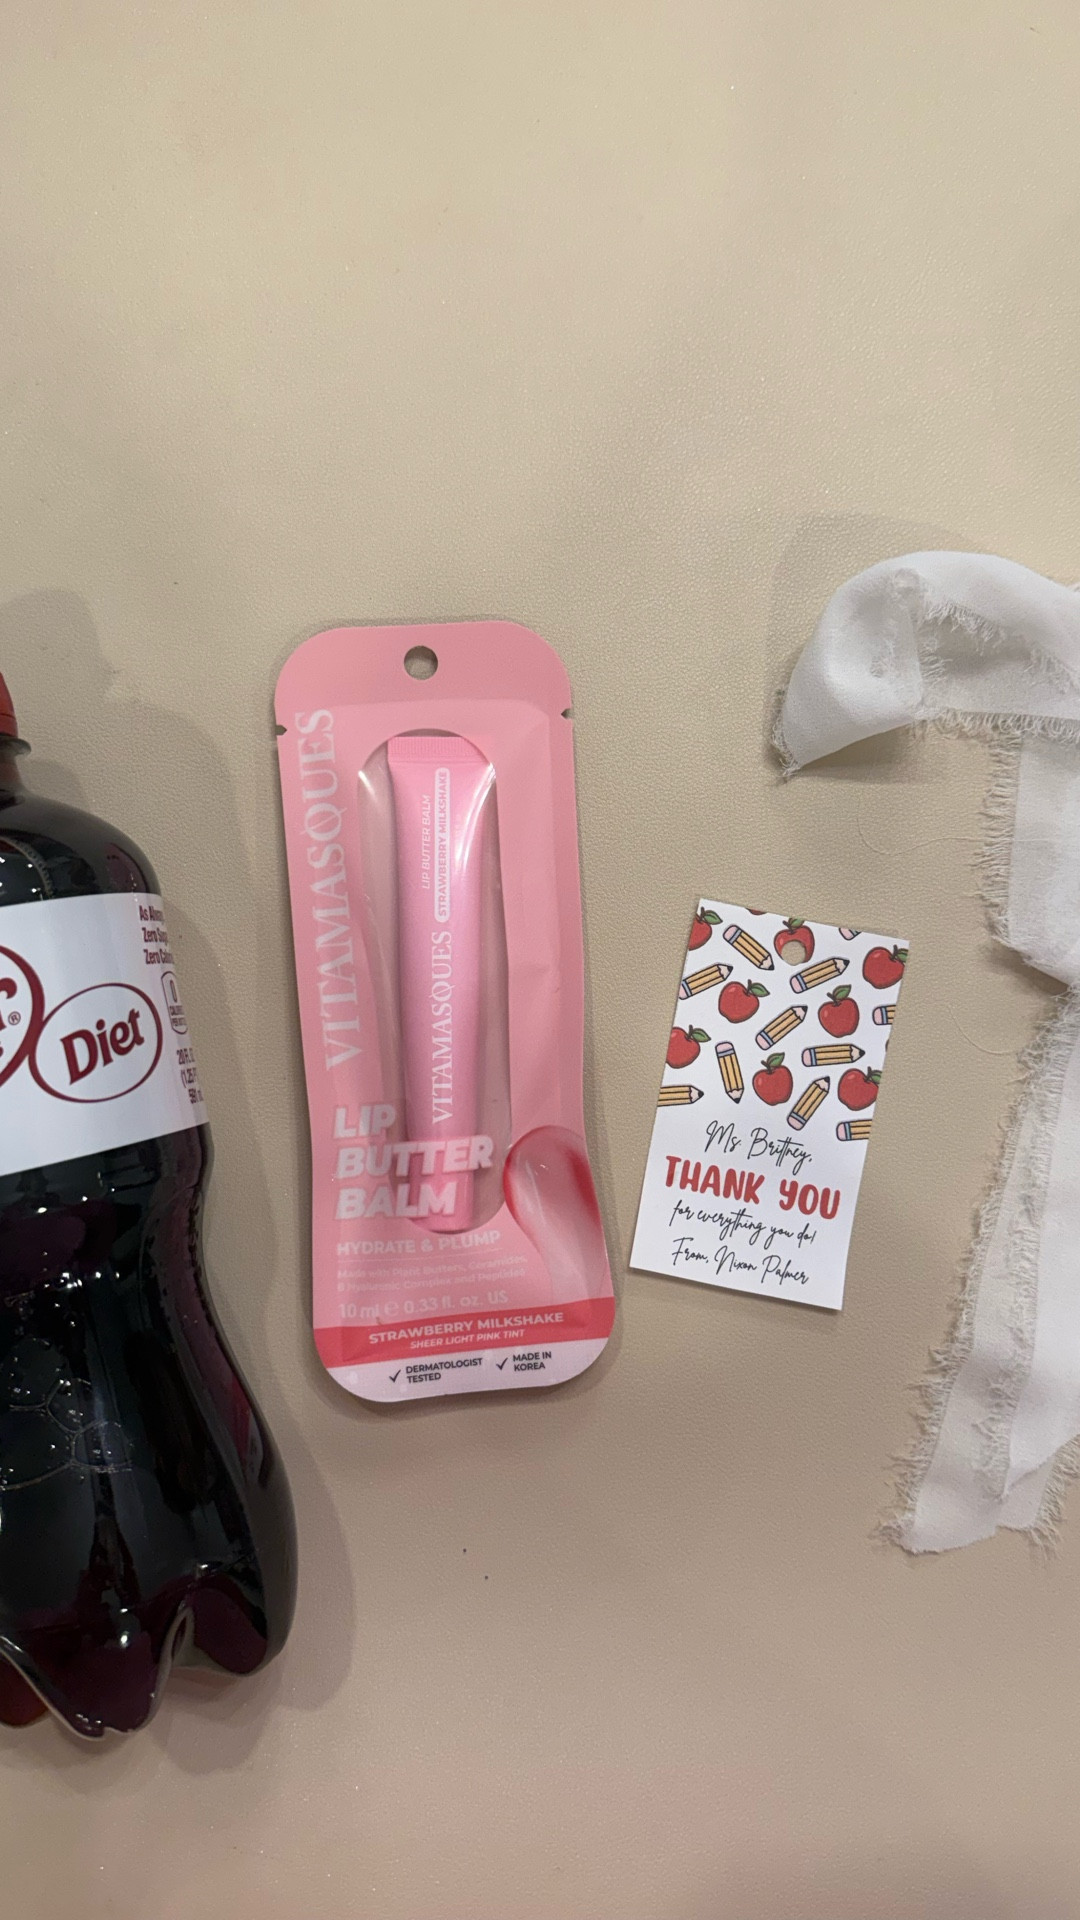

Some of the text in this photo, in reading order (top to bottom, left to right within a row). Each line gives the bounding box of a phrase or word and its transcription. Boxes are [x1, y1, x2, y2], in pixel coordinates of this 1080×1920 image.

[421, 794, 431, 890] LIP BUTTER BALM
[438, 771, 447, 917] STRAWBERRY MILKSHAKE
[295, 708, 362, 1072] VITAMASQUES
[142, 927, 158, 942] Zero
[143, 949, 160, 965] Zero
[429, 930, 456, 1124] VITAMASQUES
[60, 1008, 145, 1086] Diet
[333, 1104, 396, 1139] LIP
[335, 1135, 494, 1179] BUTTER
[704, 1120, 813, 1175] Ms. Brittney,
[335, 1181, 456, 1219] BALM
[665, 1155, 841, 1220] THANK YOU
[669, 1199, 817, 1250] for everything you do!
[336, 1230, 501, 1256] HYDRATE & PLUMP
[672, 1237, 810, 1285] From, Nixon Palmer
[339, 1303, 357, 1318] 10
[360, 1303, 380, 1319] ml
[403, 1298, 438, 1314] 0.33
[460, 1296, 484, 1307] oz.
[487, 1289, 509, 1305] US
[369, 1312, 564, 1344] STRAWBERRY MILKSHAKE
[410, 1329, 525, 1349] SHEER LIGHT PINK TINT
[405, 1357, 483, 1374] DERMATOLOGIST
[512, 1351, 552, 1362] MADE IN
[514, 1362, 546, 1372] KOREA
[407, 1372, 441, 1384] TESTED
